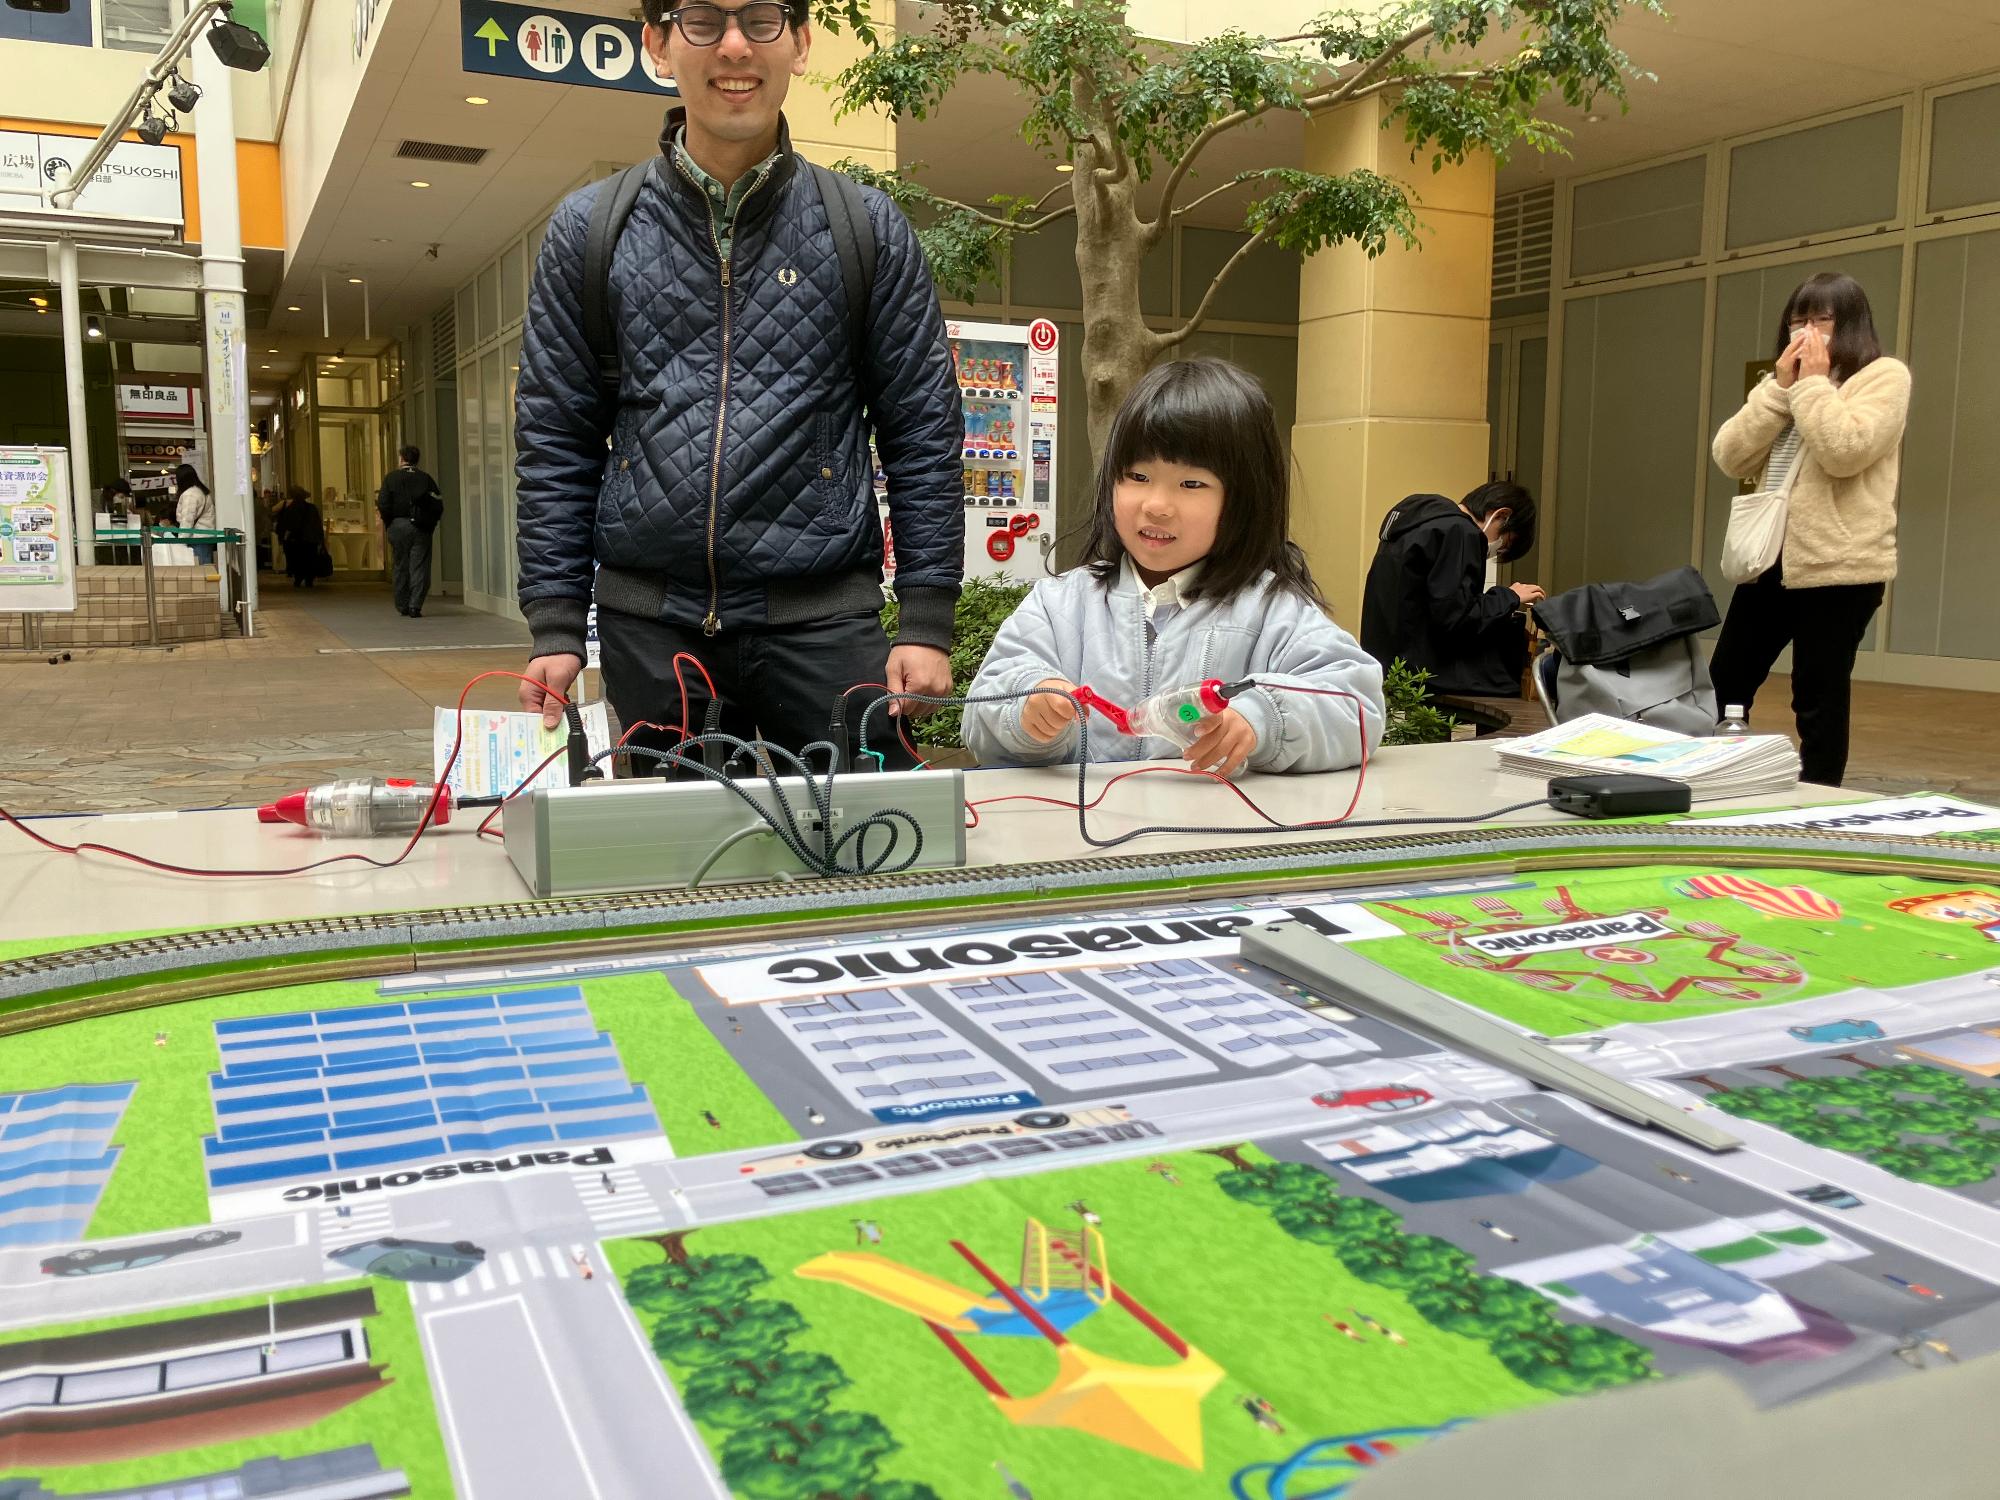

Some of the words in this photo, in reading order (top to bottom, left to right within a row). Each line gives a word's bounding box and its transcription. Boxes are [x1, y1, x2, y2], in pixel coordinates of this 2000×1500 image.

[596, 34, 622, 70] P
[3, 154, 35, 169] 広場
[97, 163, 178, 179] ITSUKOSHI
[130, 389, 178, 401] 無印良品
[1478, 916, 1667, 952] Panasonic
[891, 1093, 1022, 1117] Panasonic
[282, 1146, 615, 1203] Panasonic
